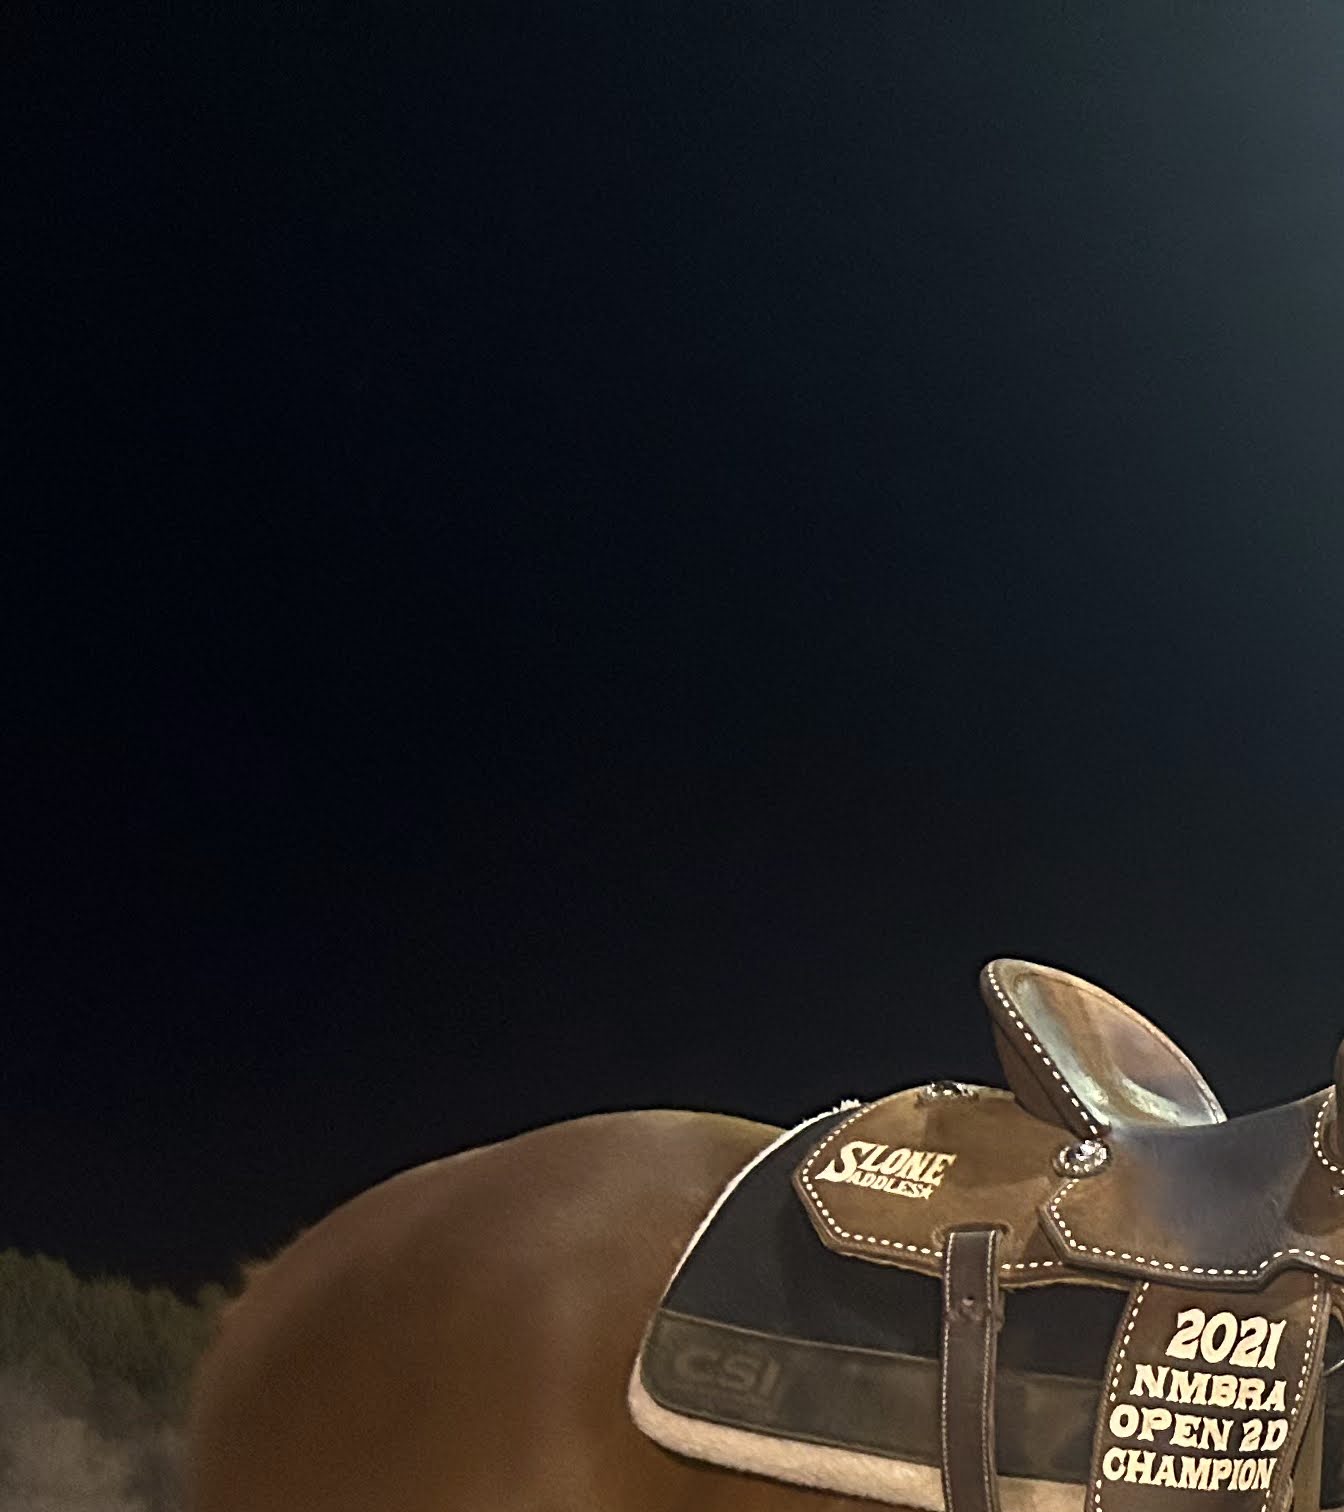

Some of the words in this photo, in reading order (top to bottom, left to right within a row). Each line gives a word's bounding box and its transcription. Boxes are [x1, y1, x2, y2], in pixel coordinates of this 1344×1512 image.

[814, 1140, 957, 1187] SLONE
[1165, 1308, 1287, 1369] 2021
[674, 1350, 780, 1396] CSI
[1129, 1364, 1287, 1411] NMBRA
[1109, 1404, 1234, 1451] OPEN
[1239, 1418, 1289, 1452] 2D
[1102, 1446, 1278, 1491] CHAMPION
